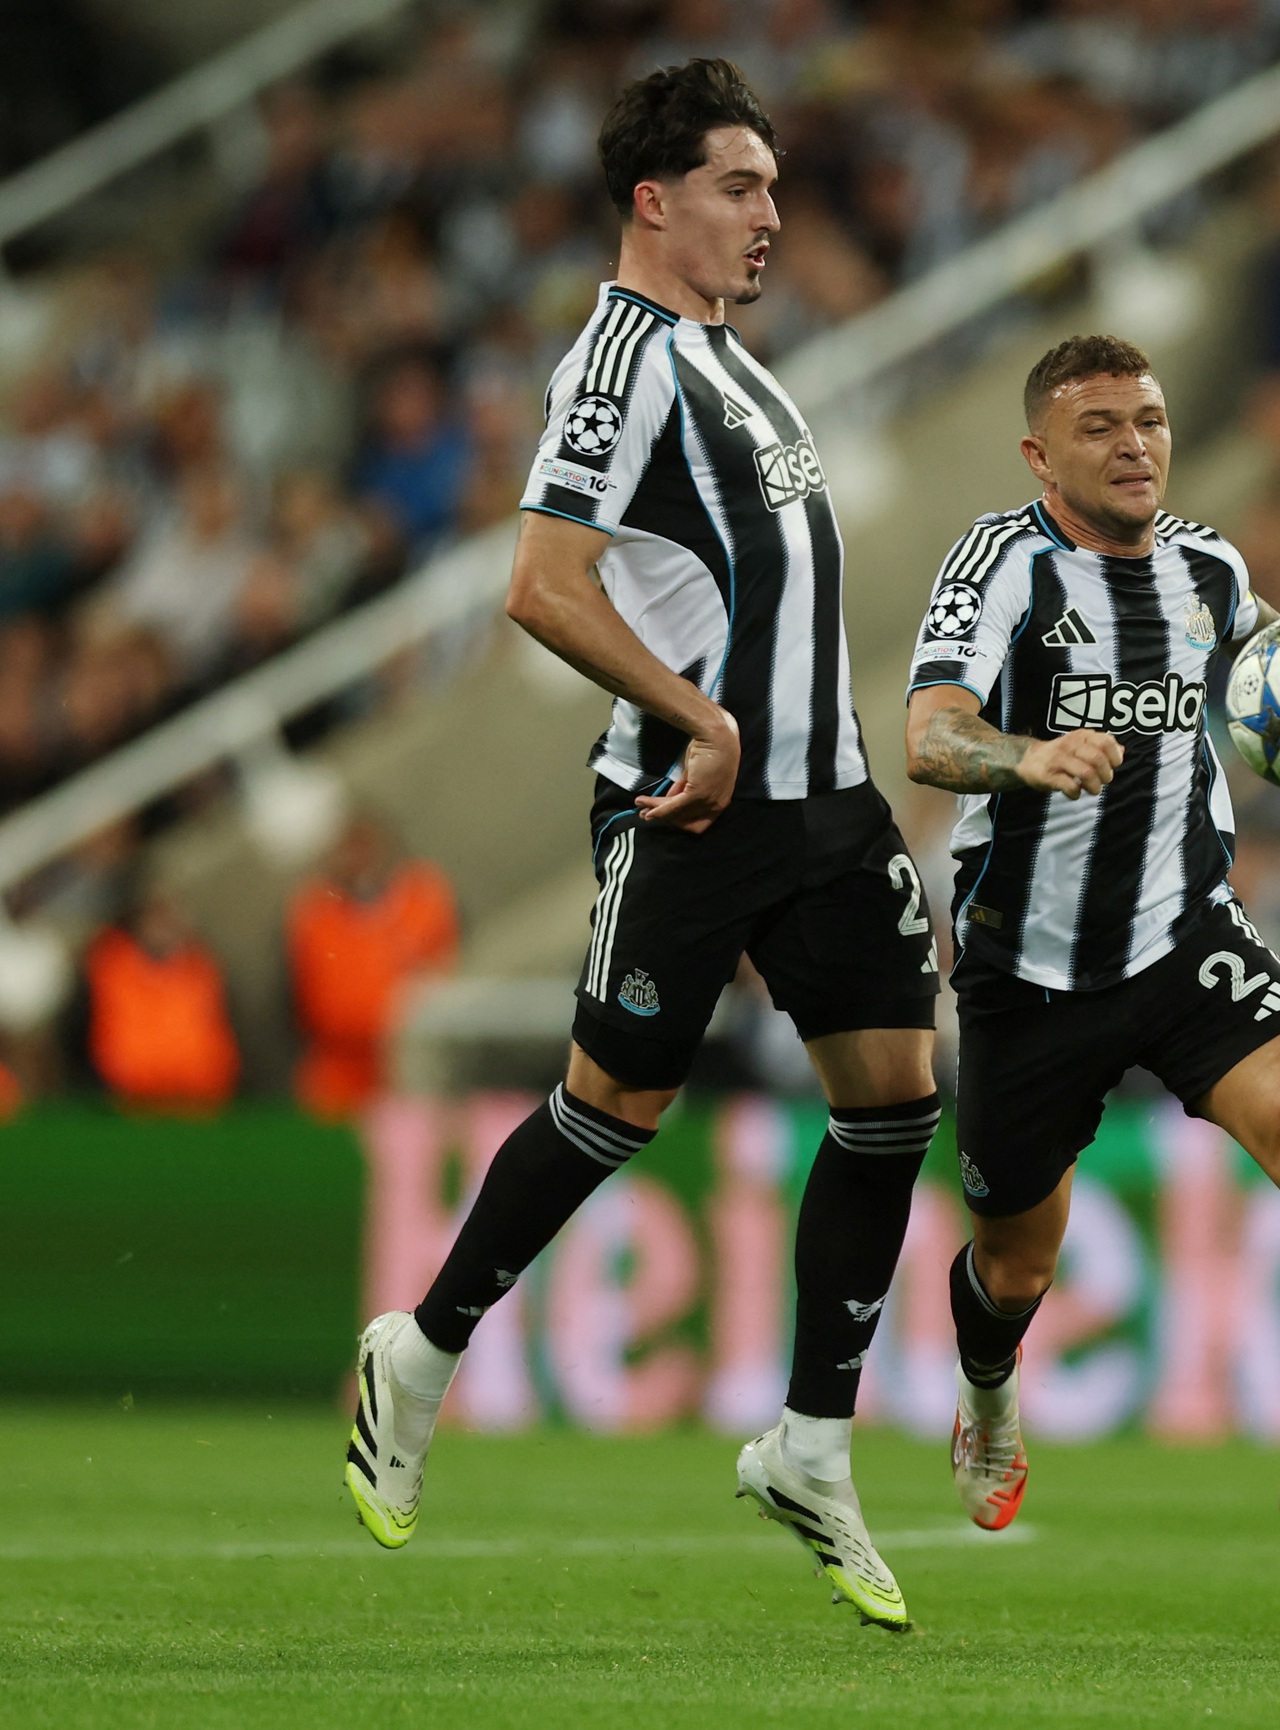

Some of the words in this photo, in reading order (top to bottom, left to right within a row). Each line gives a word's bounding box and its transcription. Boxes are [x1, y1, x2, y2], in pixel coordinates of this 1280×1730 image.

[540, 464, 588, 484] FOUNDATION
[1109, 678, 1204, 727] sela
[888, 853, 929, 937] 2
[1198, 950, 1271, 1003] 2
